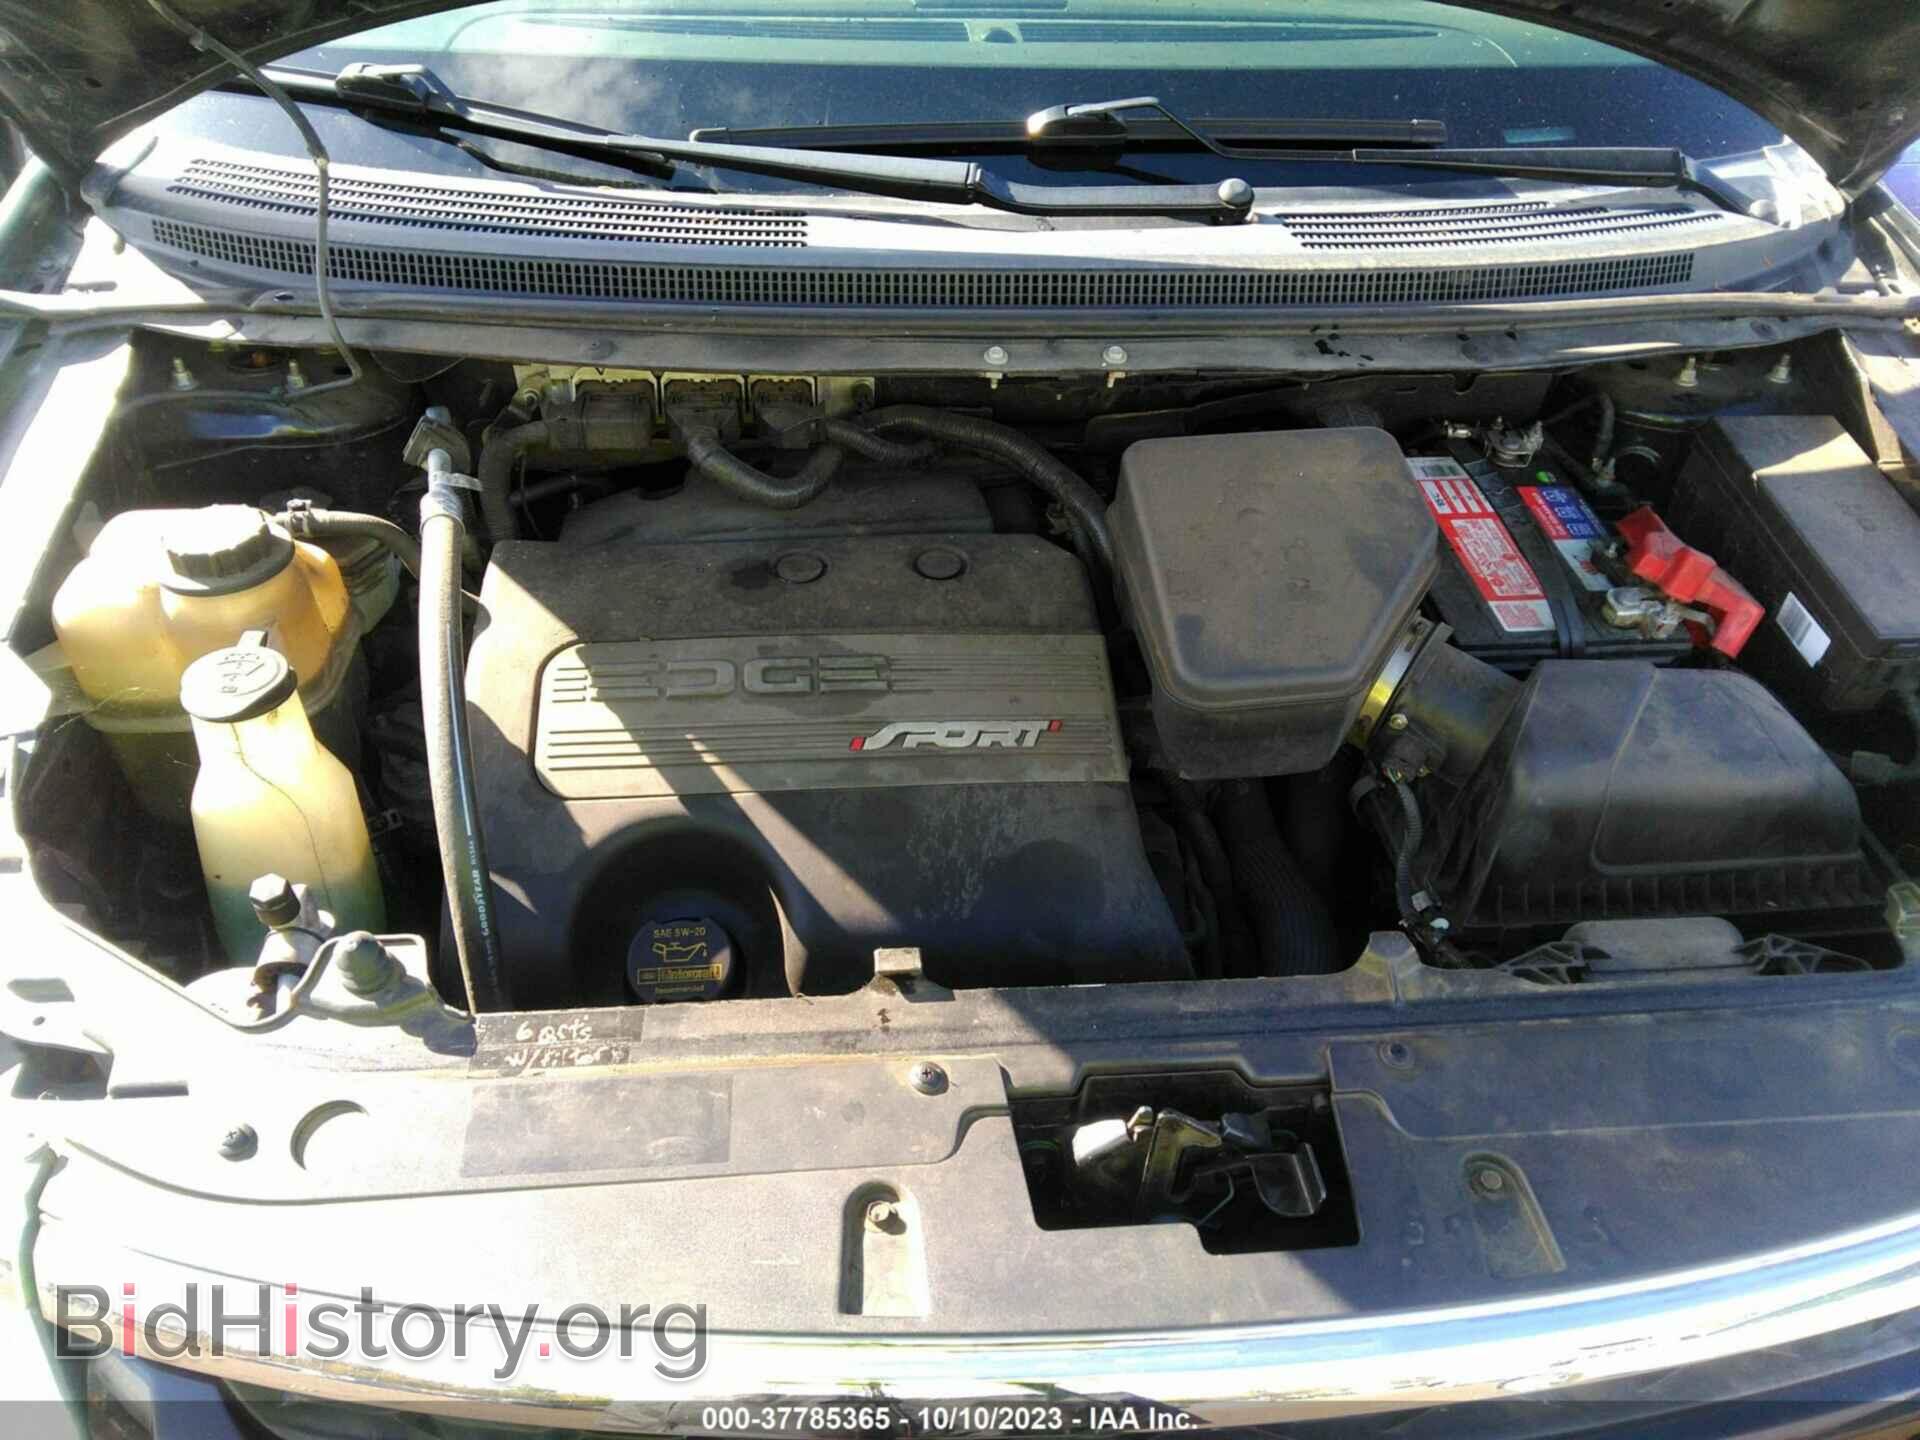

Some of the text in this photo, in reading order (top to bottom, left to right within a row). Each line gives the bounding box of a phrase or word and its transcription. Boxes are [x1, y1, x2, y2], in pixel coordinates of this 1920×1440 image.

[588, 655, 890, 700] EDGE
[862, 720, 1051, 751] SPORT
[472, 868, 490, 937] GOODYEAR
[653, 926, 706, 938] SAE 5W-20
[515, 1020, 534, 1041] 6
